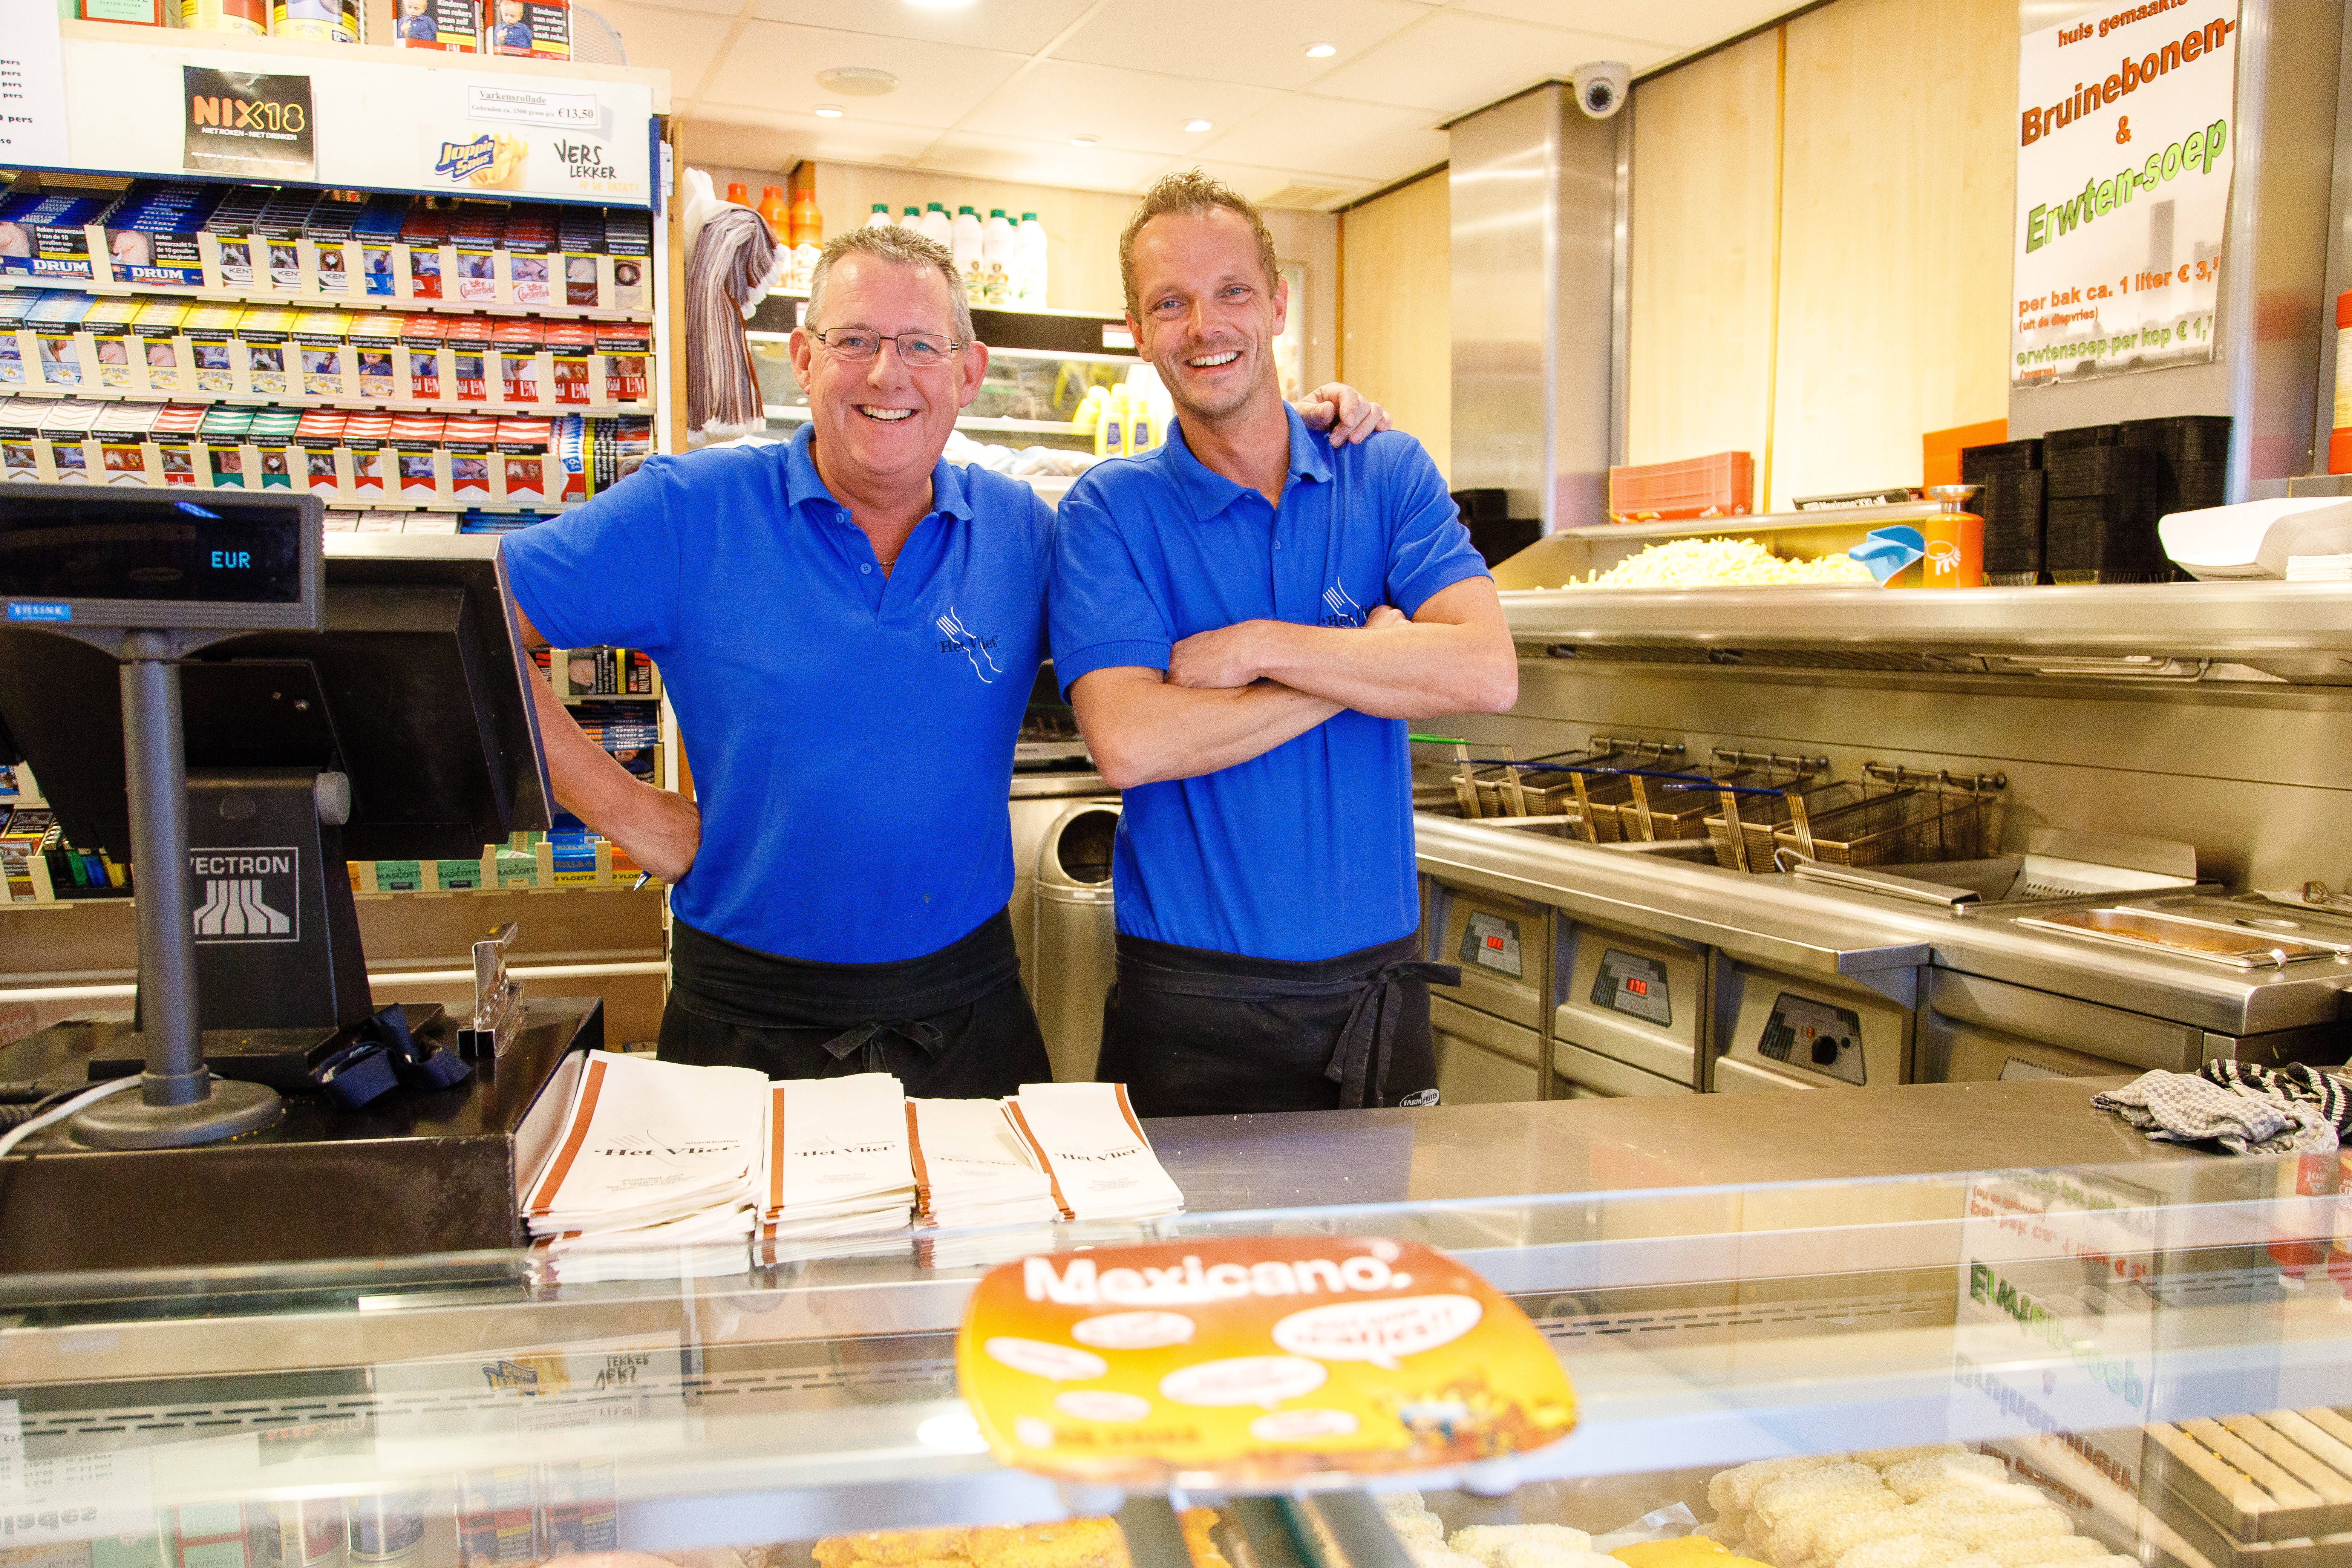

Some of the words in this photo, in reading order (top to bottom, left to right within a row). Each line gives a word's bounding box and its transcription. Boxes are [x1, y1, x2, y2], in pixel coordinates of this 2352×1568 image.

[437, 0, 468, 9] Kinderen
[533, 7, 562, 17] Kinderen
[546, 17, 567, 26] rokers
[2058, 23, 2093, 47] huis
[2021, 18, 2235, 147] Bruinebonen-
[479, 90, 547, 104] Varkensrollade
[193, 95, 305, 132] NIX18
[559, 107, 594, 120] €13,50
[266, 132, 297, 141] DRINKEN
[2116, 115, 2132, 144] &
[439, 139, 493, 165] Joppie
[554, 138, 602, 165] VERS
[455, 154, 489, 175] Saus
[570, 165, 617, 180] LEKKER
[607, 183, 639, 193] PATAT!
[2026, 119, 2226, 254] Erwten-soep
[33, 259, 90, 272] DRUM
[132, 267, 184, 279] DRUM
[2019, 297, 2046, 317] per
[2052, 286, 2081, 307] bak
[2087, 285, 2113, 301] ca.
[2120, 276, 2128, 294] 1
[2135, 271, 2172, 291] liter
[2178, 264, 2190, 283] €
[2019, 319, 2035, 334] (uit
[2038, 317, 2049, 327] de
[2052, 306, 2098, 326] diepvries)
[2017, 338, 2107, 366] erwtensoep
[2112, 332, 2138, 355] per
[2142, 327, 2171, 348] kop
[2177, 320, 2188, 340] €
[626, 377, 645, 393] L&M
[211, 551, 250, 568] EUR
[377, 870, 421, 880] MASCOTT
[1404, 1098, 1422, 1107] FARM
[1423, 1093, 1438, 1103] FRITES
